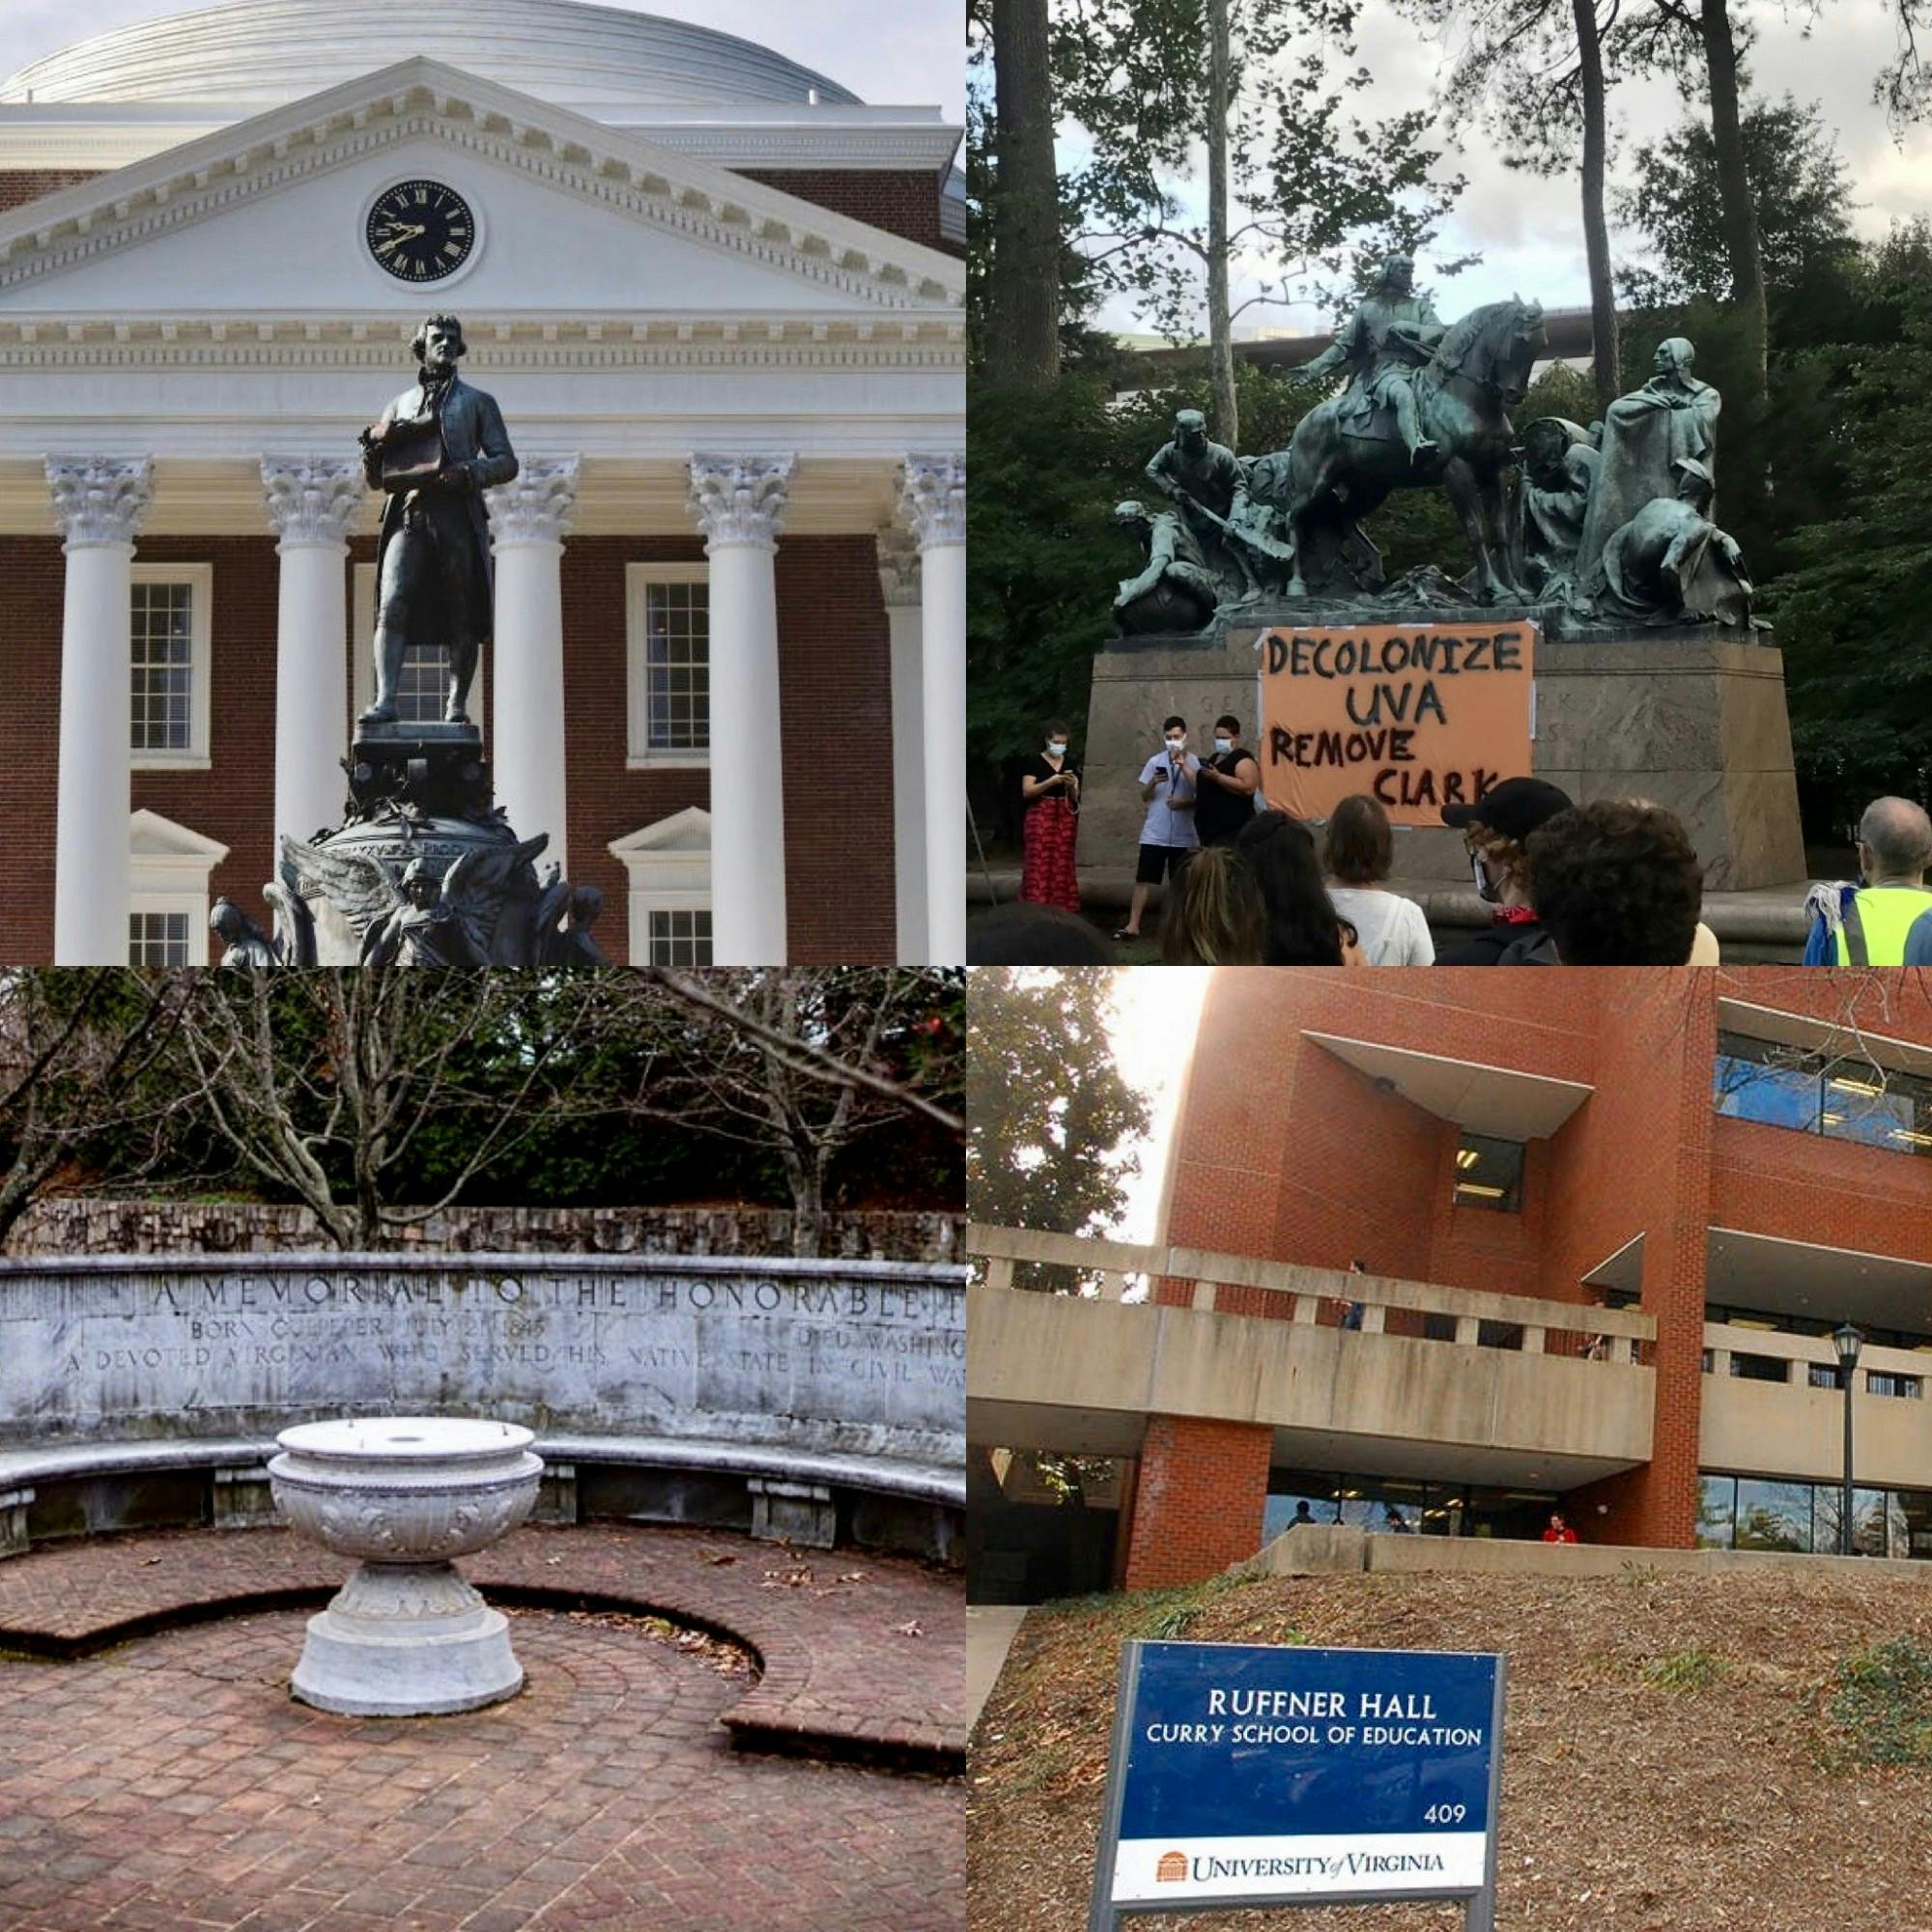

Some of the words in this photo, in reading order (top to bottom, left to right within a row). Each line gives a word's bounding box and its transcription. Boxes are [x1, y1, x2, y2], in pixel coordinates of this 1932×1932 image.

[1267, 633, 1523, 678] DECOLONIZE
[1346, 680, 1448, 725] UVA
[1269, 726, 1416, 768] REMOVE
[1374, 768, 1498, 807] CLARK
[547, 1278, 626, 1306] THE
[658, 1281, 918, 1319] HONORABLE
[1208, 1689, 1347, 1718] RUFFNER
[1359, 1692, 1437, 1719] HALL
[1146, 1722, 1224, 1743] CURRY
[1232, 1724, 1320, 1744] SCHOOL
[1327, 1725, 1356, 1745] OF
[1363, 1726, 1483, 1747] EDUCATION
[1424, 1804, 1466, 1824] 409
[1327, 1855, 1344, 1880] of
